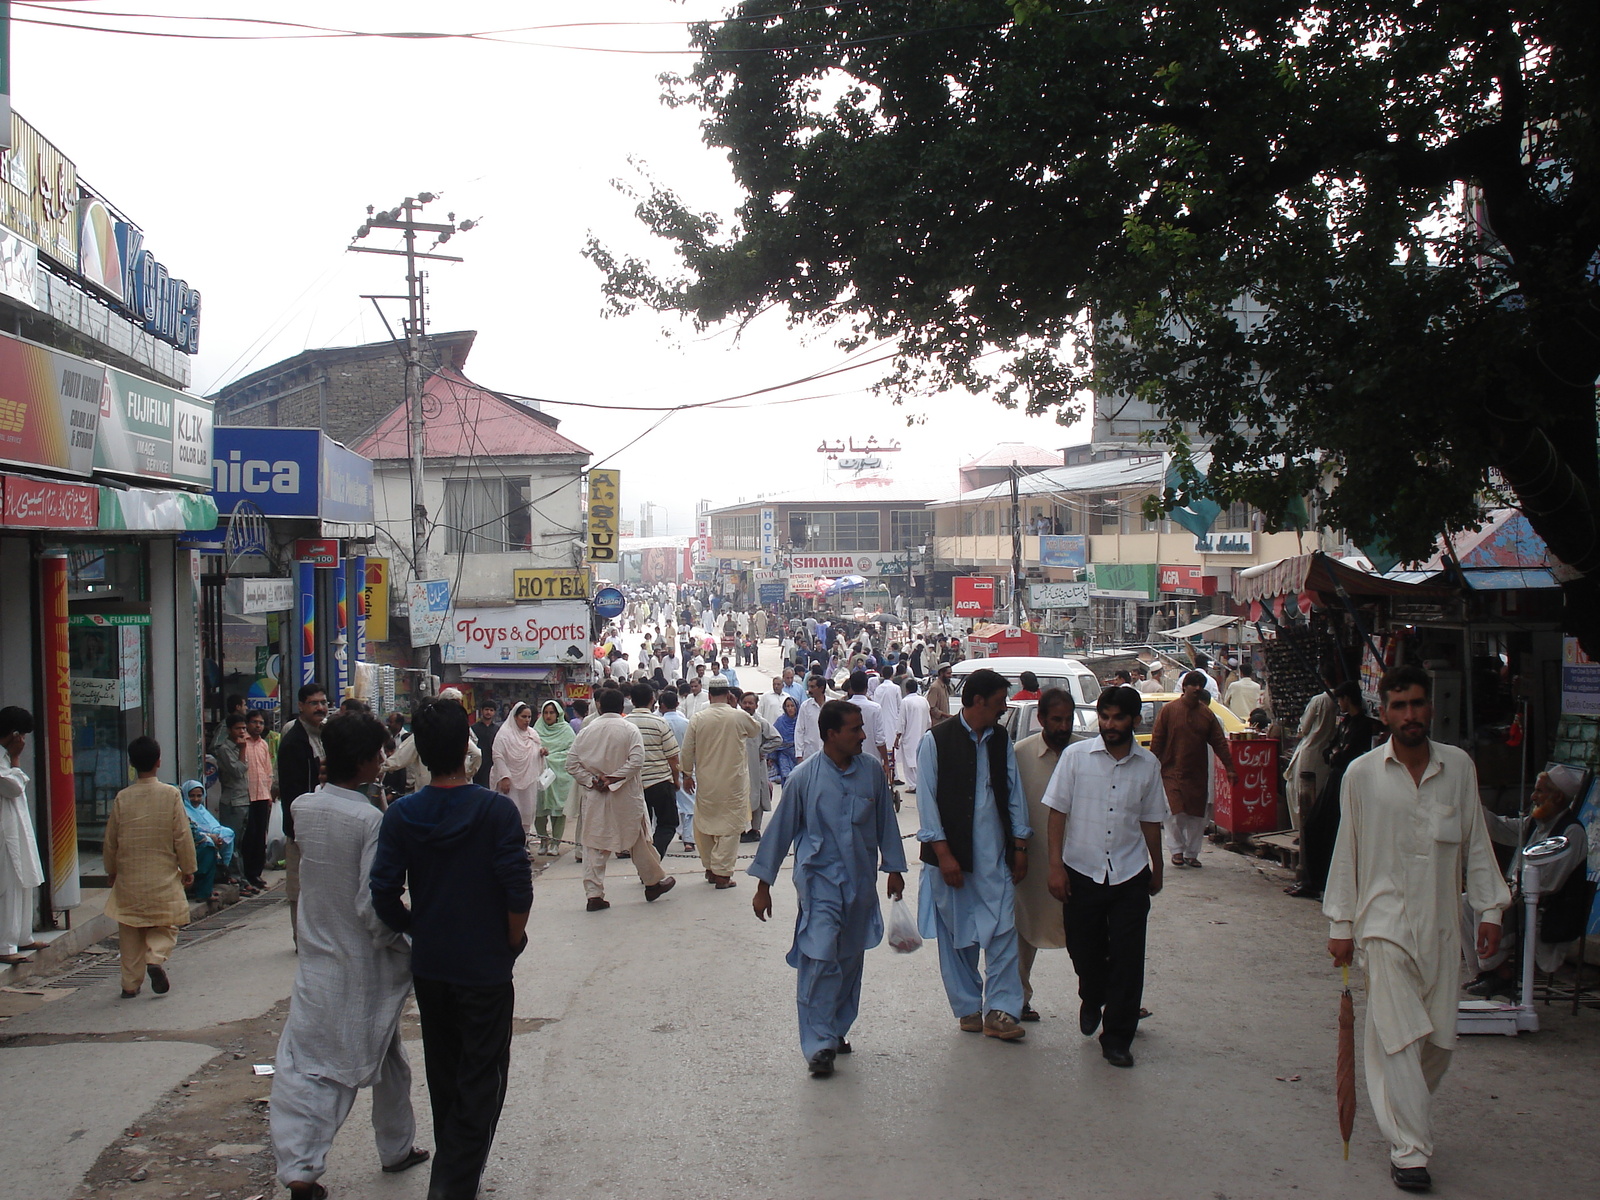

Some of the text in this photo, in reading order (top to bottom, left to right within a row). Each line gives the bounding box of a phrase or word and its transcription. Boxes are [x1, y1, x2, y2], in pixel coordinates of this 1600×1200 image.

[61, 369, 81, 399] PHOTO
[70, 409, 96, 431] COLOR LAB
[127, 391, 170, 428] FUJIFILM
[177, 411, 203, 444] KLIK
[75, 431, 94, 450] STUDIO
[136, 440, 155, 457] IMAGE
[146, 459, 169, 473] SERVICE
[179, 445, 207, 466] COLOR LAB
[213, 450, 299, 495] nica
[763, 510, 772, 566] HOTEL
[518, 577, 585, 597] HOTEL
[1162, 570, 1180, 585] AGFA
[365, 586, 373, 621] Kodak
[1066, 584, 1088, 601] پاکستان
[956, 601, 981, 609] AGFA
[109, 615, 150, 624] FUJIFILM
[456, 617, 508, 649] Toys
[510, 626, 523, 642] &
[525, 618, 585, 649] Sports
[56, 651, 74, 776] EXPRESS
[1244, 768, 1268, 792] پان
